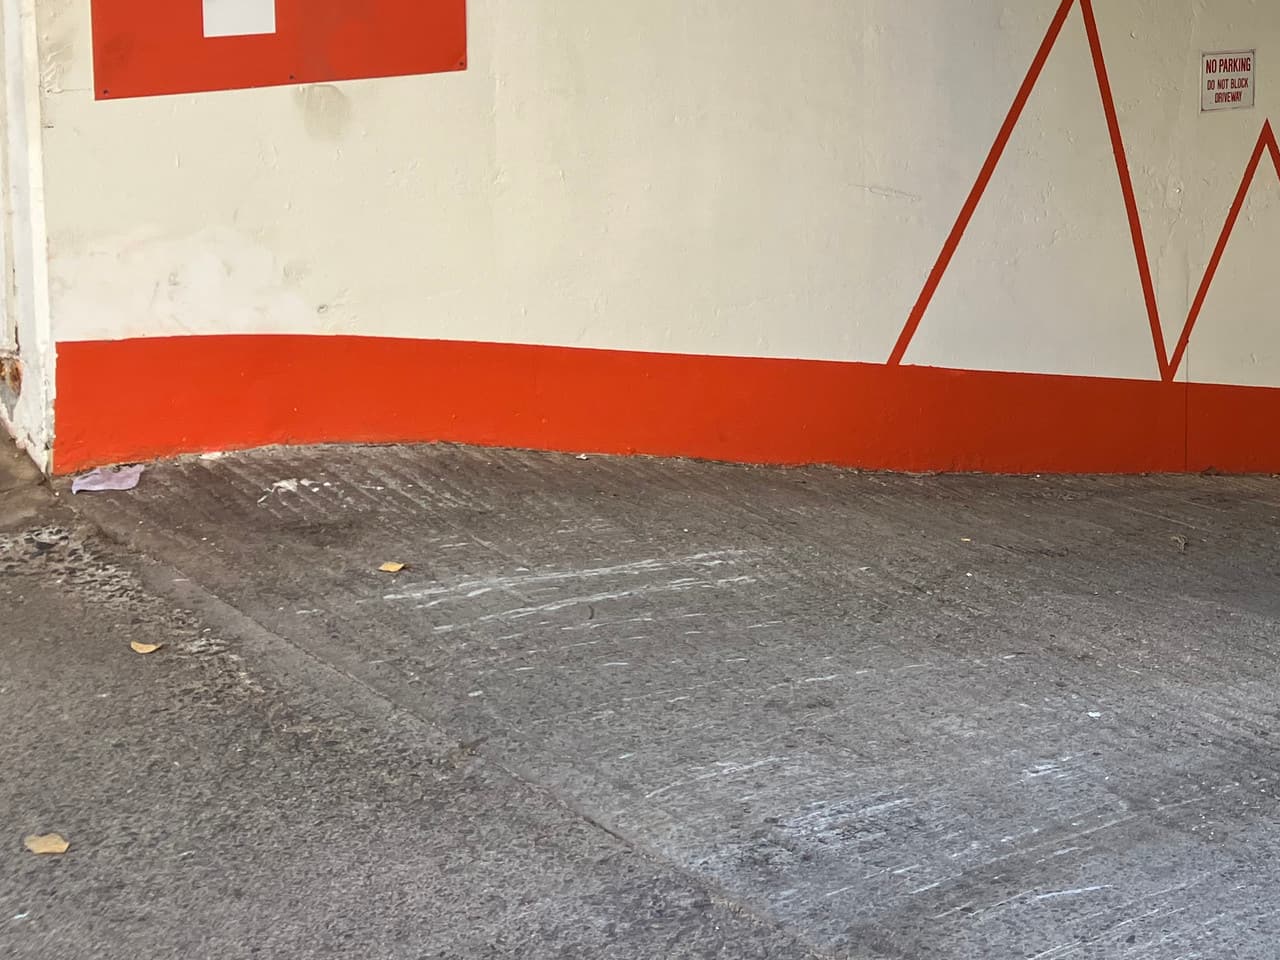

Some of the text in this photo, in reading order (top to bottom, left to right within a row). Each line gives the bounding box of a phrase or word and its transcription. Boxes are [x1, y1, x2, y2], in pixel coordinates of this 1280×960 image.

[1206, 57, 1251, 73] NO PARKING
[1207, 77, 1249, 90] DO NOT BLOCK
[1214, 91, 1242, 103] DRIVEWAY
